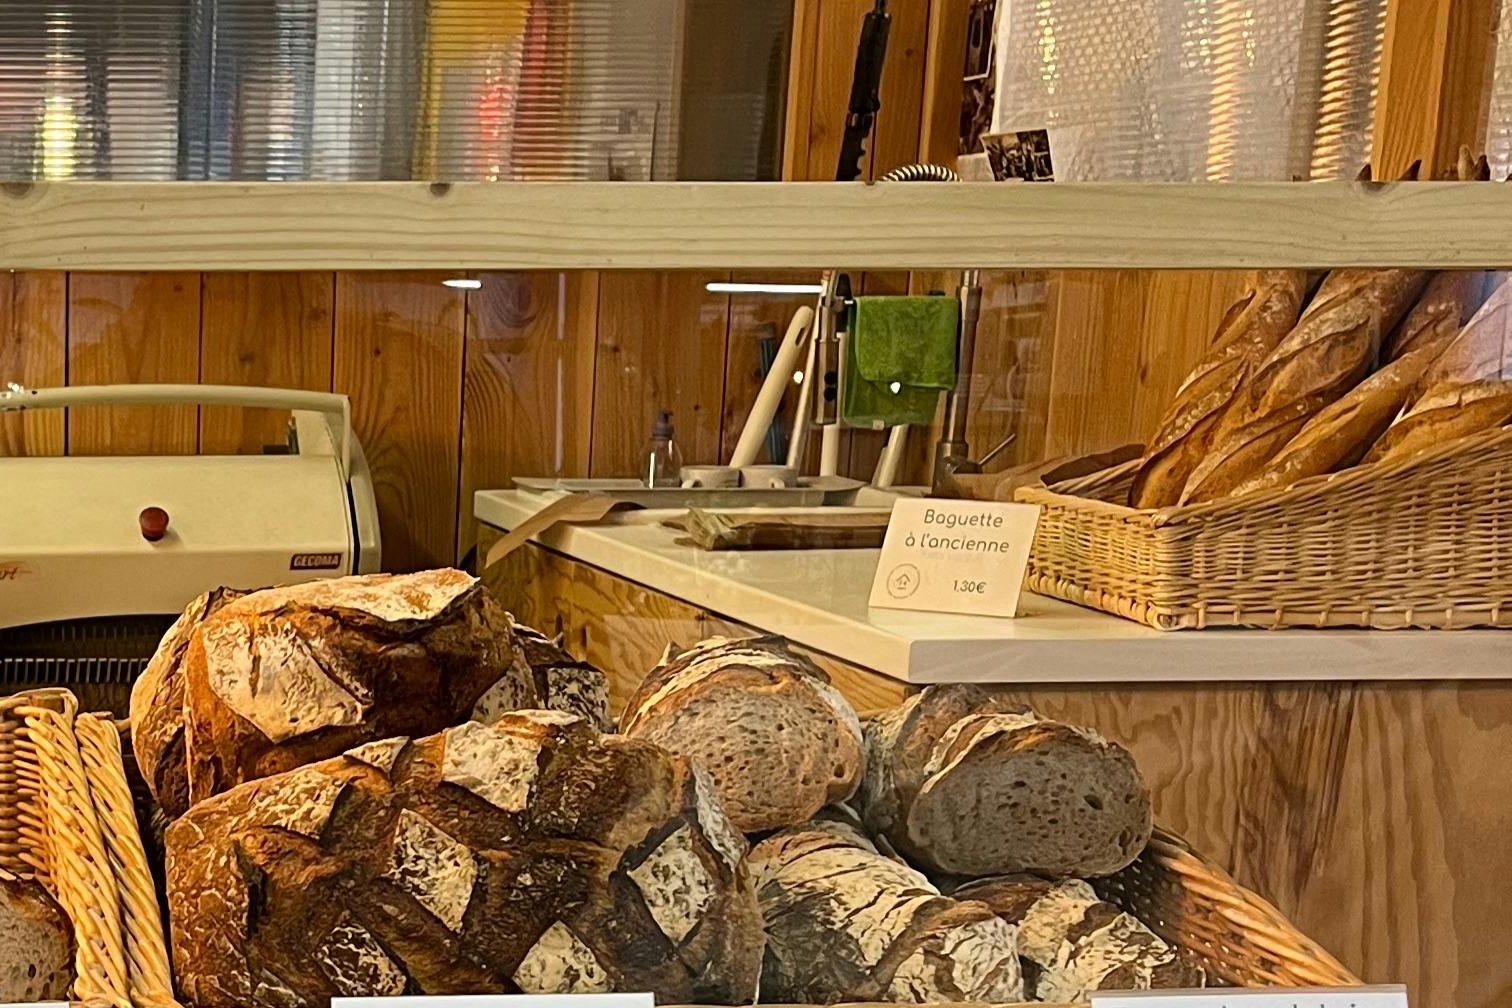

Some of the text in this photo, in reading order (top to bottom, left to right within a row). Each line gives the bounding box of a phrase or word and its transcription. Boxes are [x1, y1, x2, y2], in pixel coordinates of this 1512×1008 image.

[924, 509, 1003, 529] Baguette
[905, 532, 1009, 553] à l'ancienne
